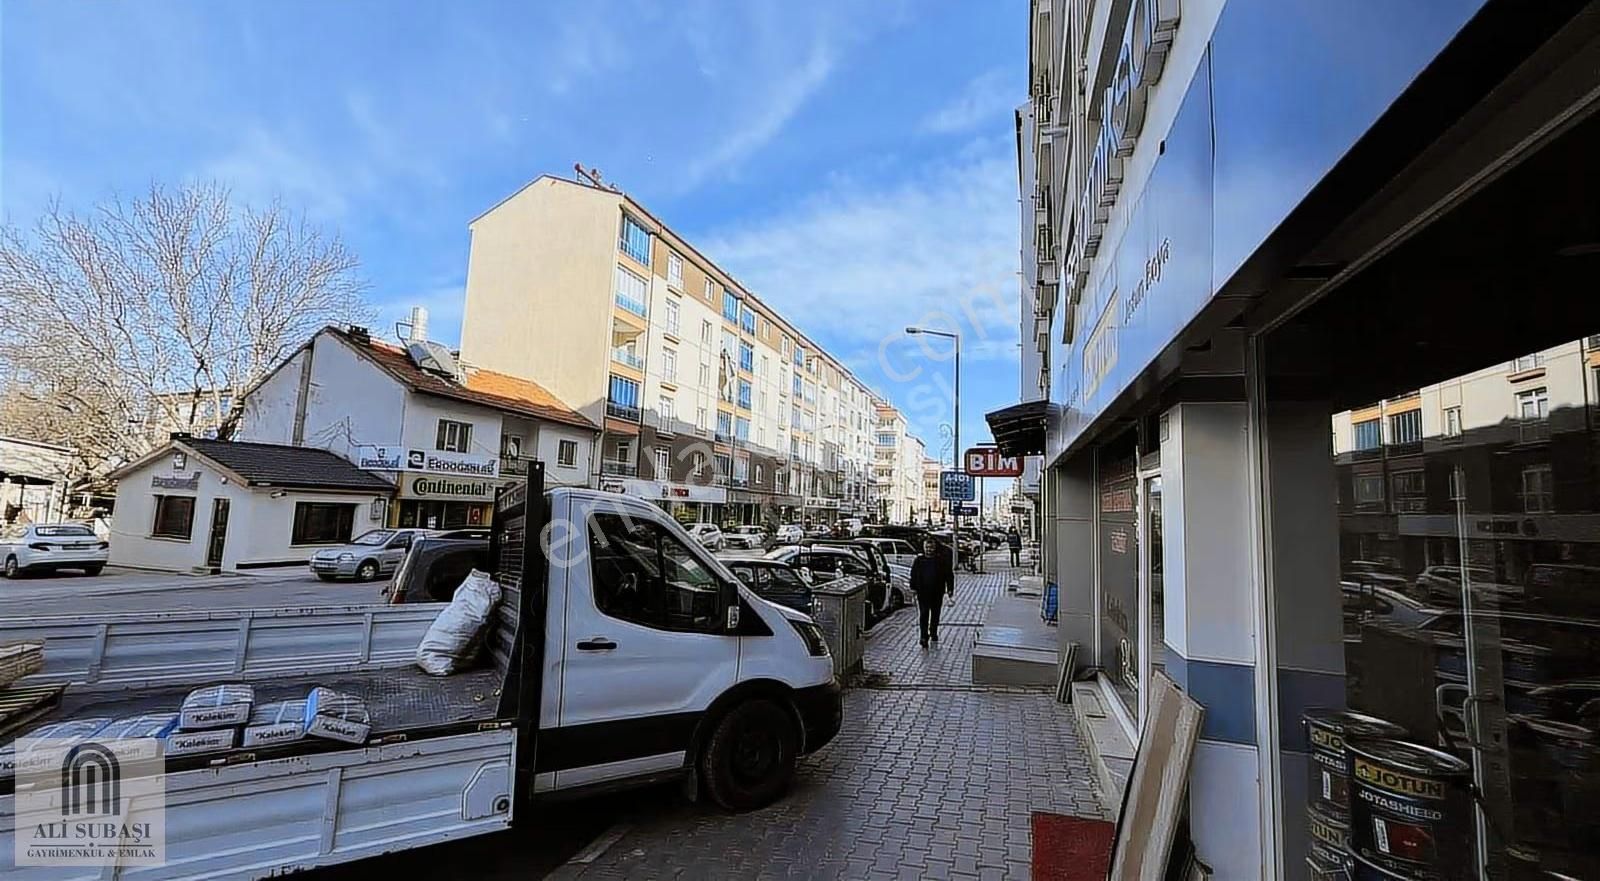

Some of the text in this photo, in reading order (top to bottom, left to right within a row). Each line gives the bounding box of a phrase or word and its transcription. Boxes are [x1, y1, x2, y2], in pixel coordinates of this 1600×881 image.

[412, 477, 487, 496] Continental
[1372, 766, 1441, 796] JOTUN
[1358, 789, 1442, 820] JOTASHIELD
